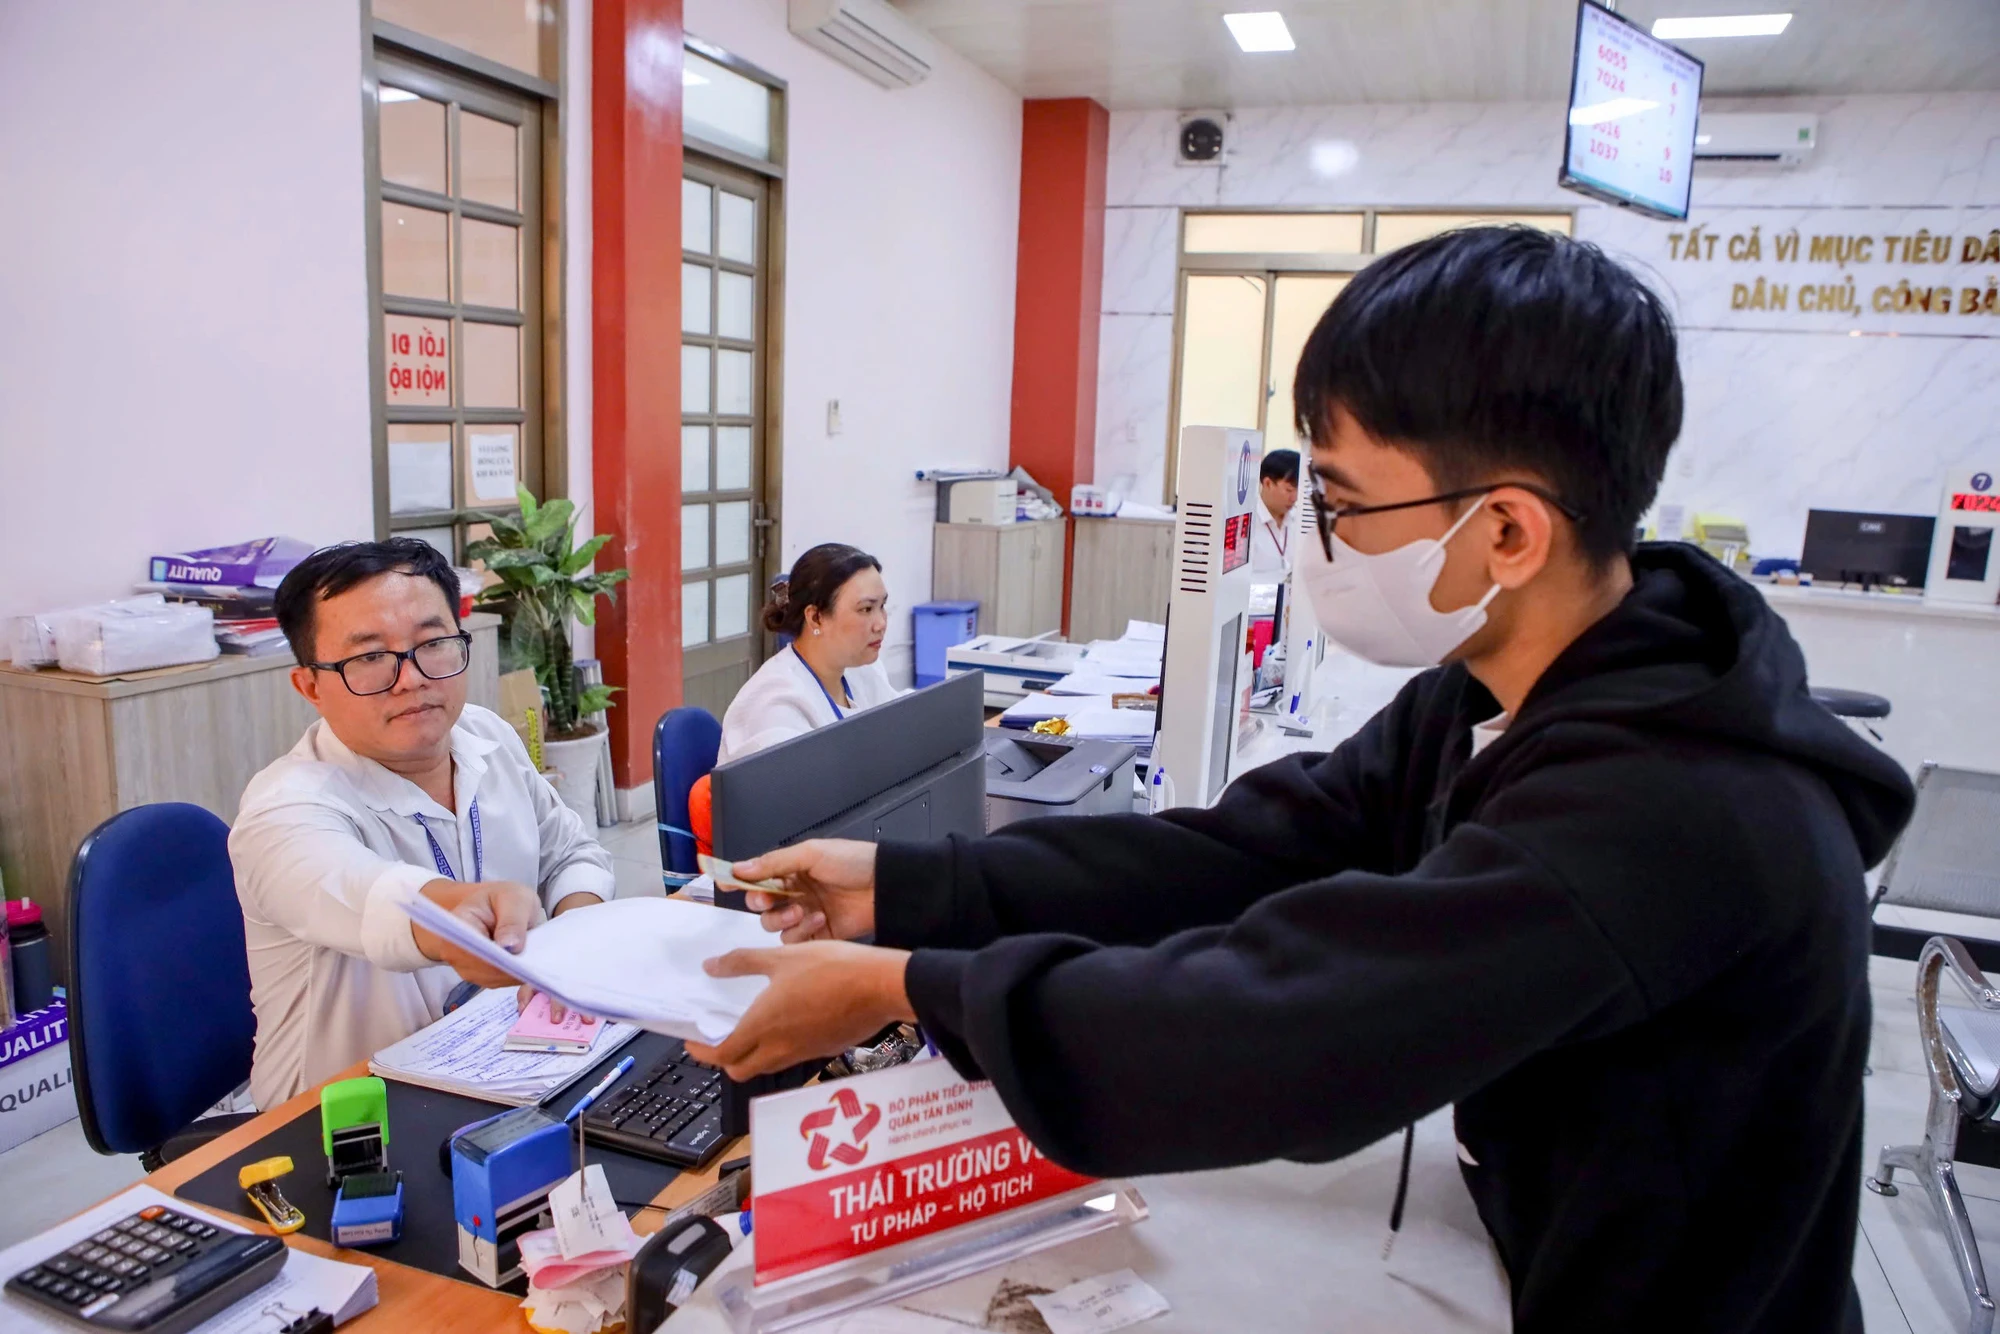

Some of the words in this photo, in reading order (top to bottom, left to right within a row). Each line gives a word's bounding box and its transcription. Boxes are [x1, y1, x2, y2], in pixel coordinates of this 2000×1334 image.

[1598, 44, 1628, 71] 6055
[1596, 67, 1626, 93] 7024
[1590, 138, 1619, 161] 1037
[1668, 223, 1719, 262] TẤT
[1728, 226, 1762, 262] CẢ
[1774, 227, 1800, 262] VÌ
[1809, 235, 1874, 268] MỤC
[1884, 228, 1952, 264] TIÊU
[1731, 276, 1788, 311] DÂN
[1872, 279, 1953, 314] CÔNG
[1238, 452, 1250, 492] 10
[1976, 474, 1988, 490] 7
[168, 564, 222, 582] QUALITY
[0, 1018, 68, 1063] UALIT
[828, 1169, 894, 1219] THÁI
[901, 1141, 1010, 1198] TRƯỜNG
[851, 1213, 878, 1245] TƯ
[883, 1202, 937, 1236] PHÁP
[959, 1186, 987, 1213] HỘ
[991, 1173, 1034, 1204] TỊCH
